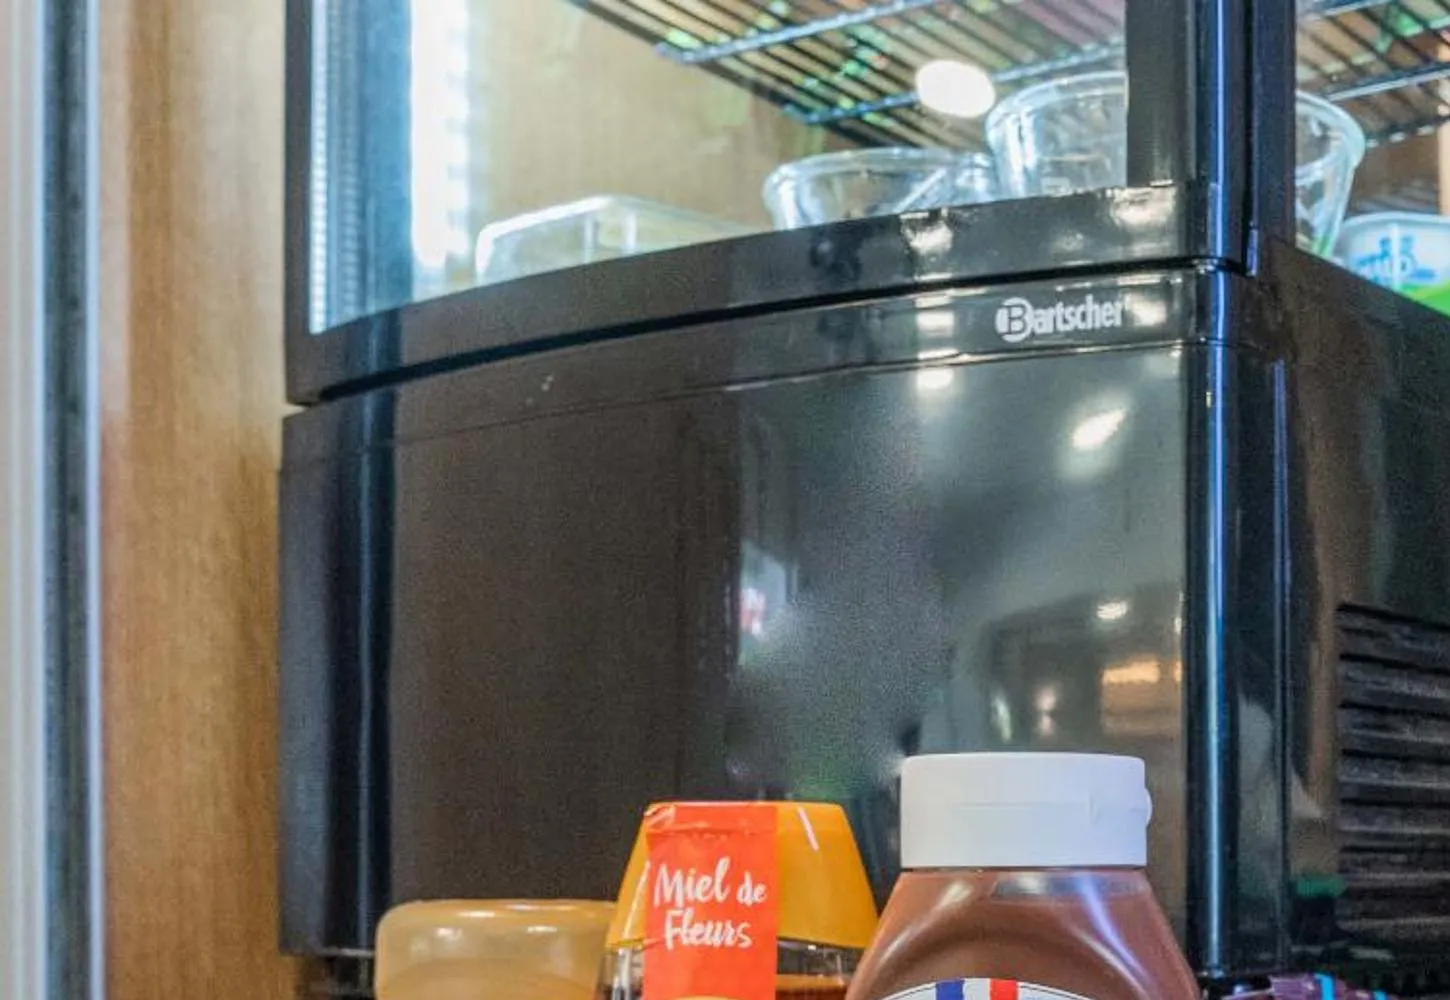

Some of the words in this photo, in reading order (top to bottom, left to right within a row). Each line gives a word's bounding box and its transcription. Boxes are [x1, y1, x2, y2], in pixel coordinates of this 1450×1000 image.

[995, 296, 1122, 343] Bartscher
[653, 856, 731, 909] Miel
[736, 871, 768, 907] de
[663, 909, 753, 952] Fleurs
